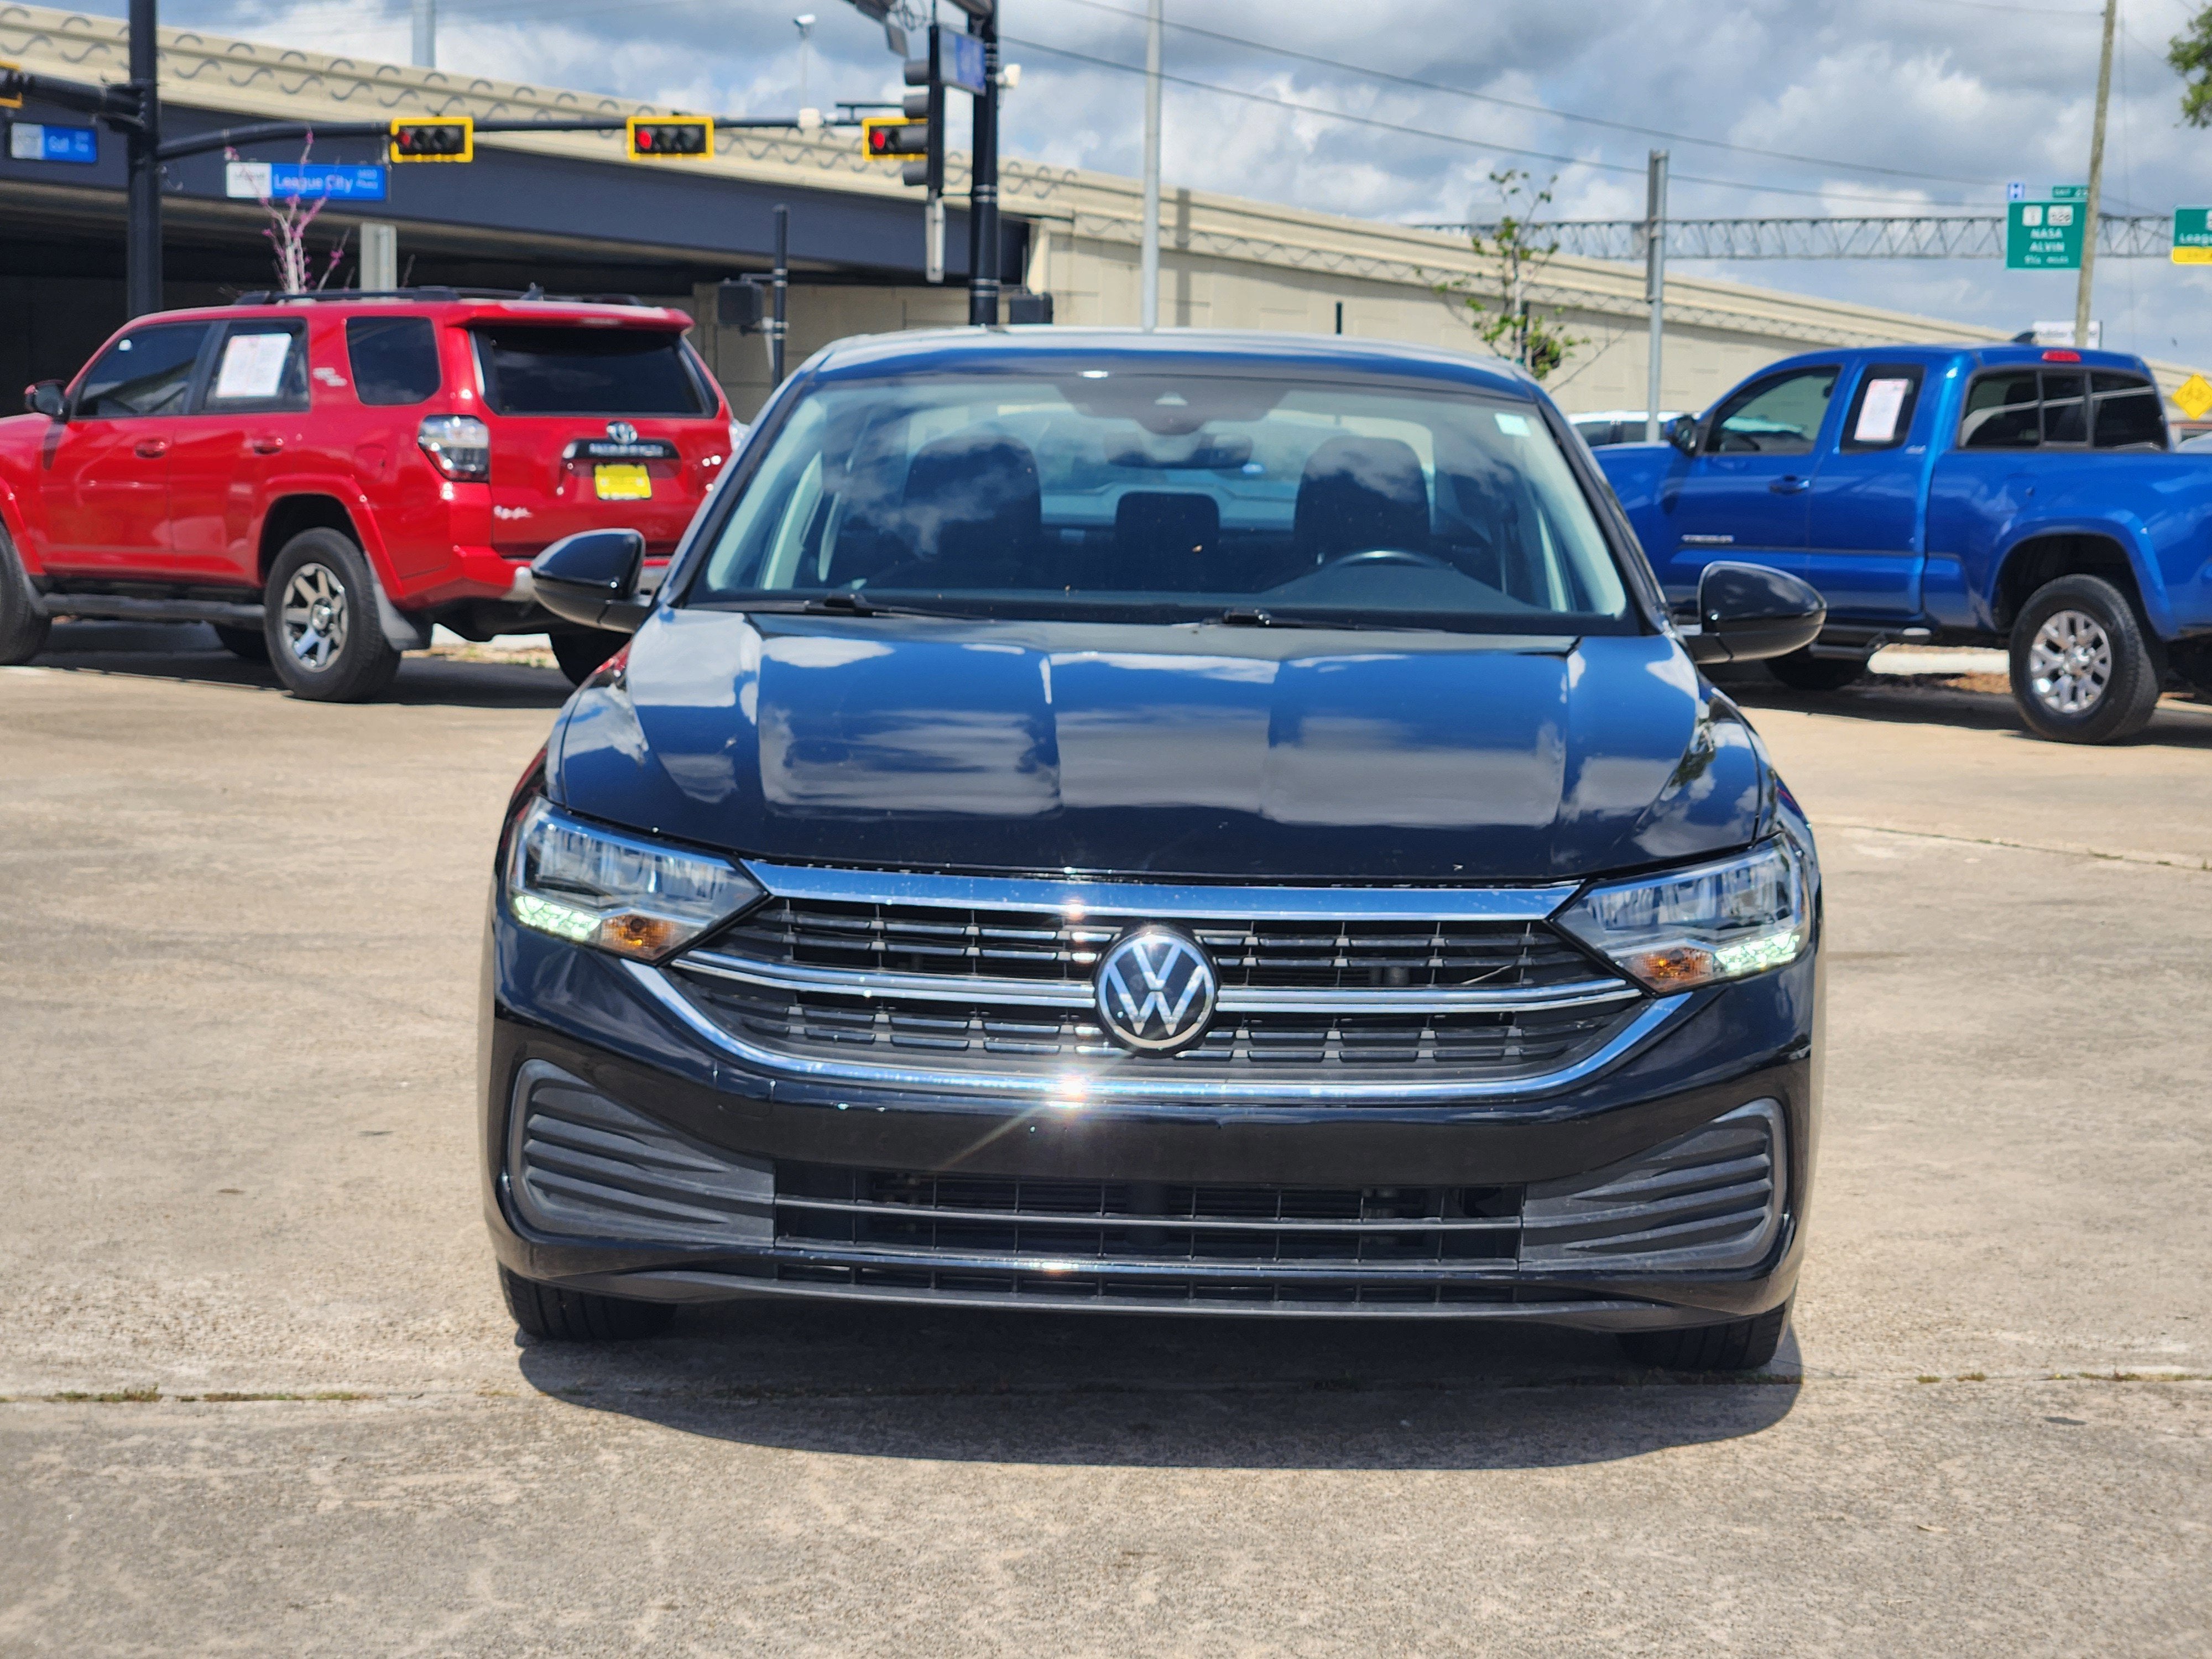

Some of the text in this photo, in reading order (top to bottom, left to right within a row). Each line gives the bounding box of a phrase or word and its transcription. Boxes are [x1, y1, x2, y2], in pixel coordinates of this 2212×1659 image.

[273, 174, 324, 194] League
[2030, 227, 2063, 239] NASA
[2029, 241, 2065, 253] ALVIN
